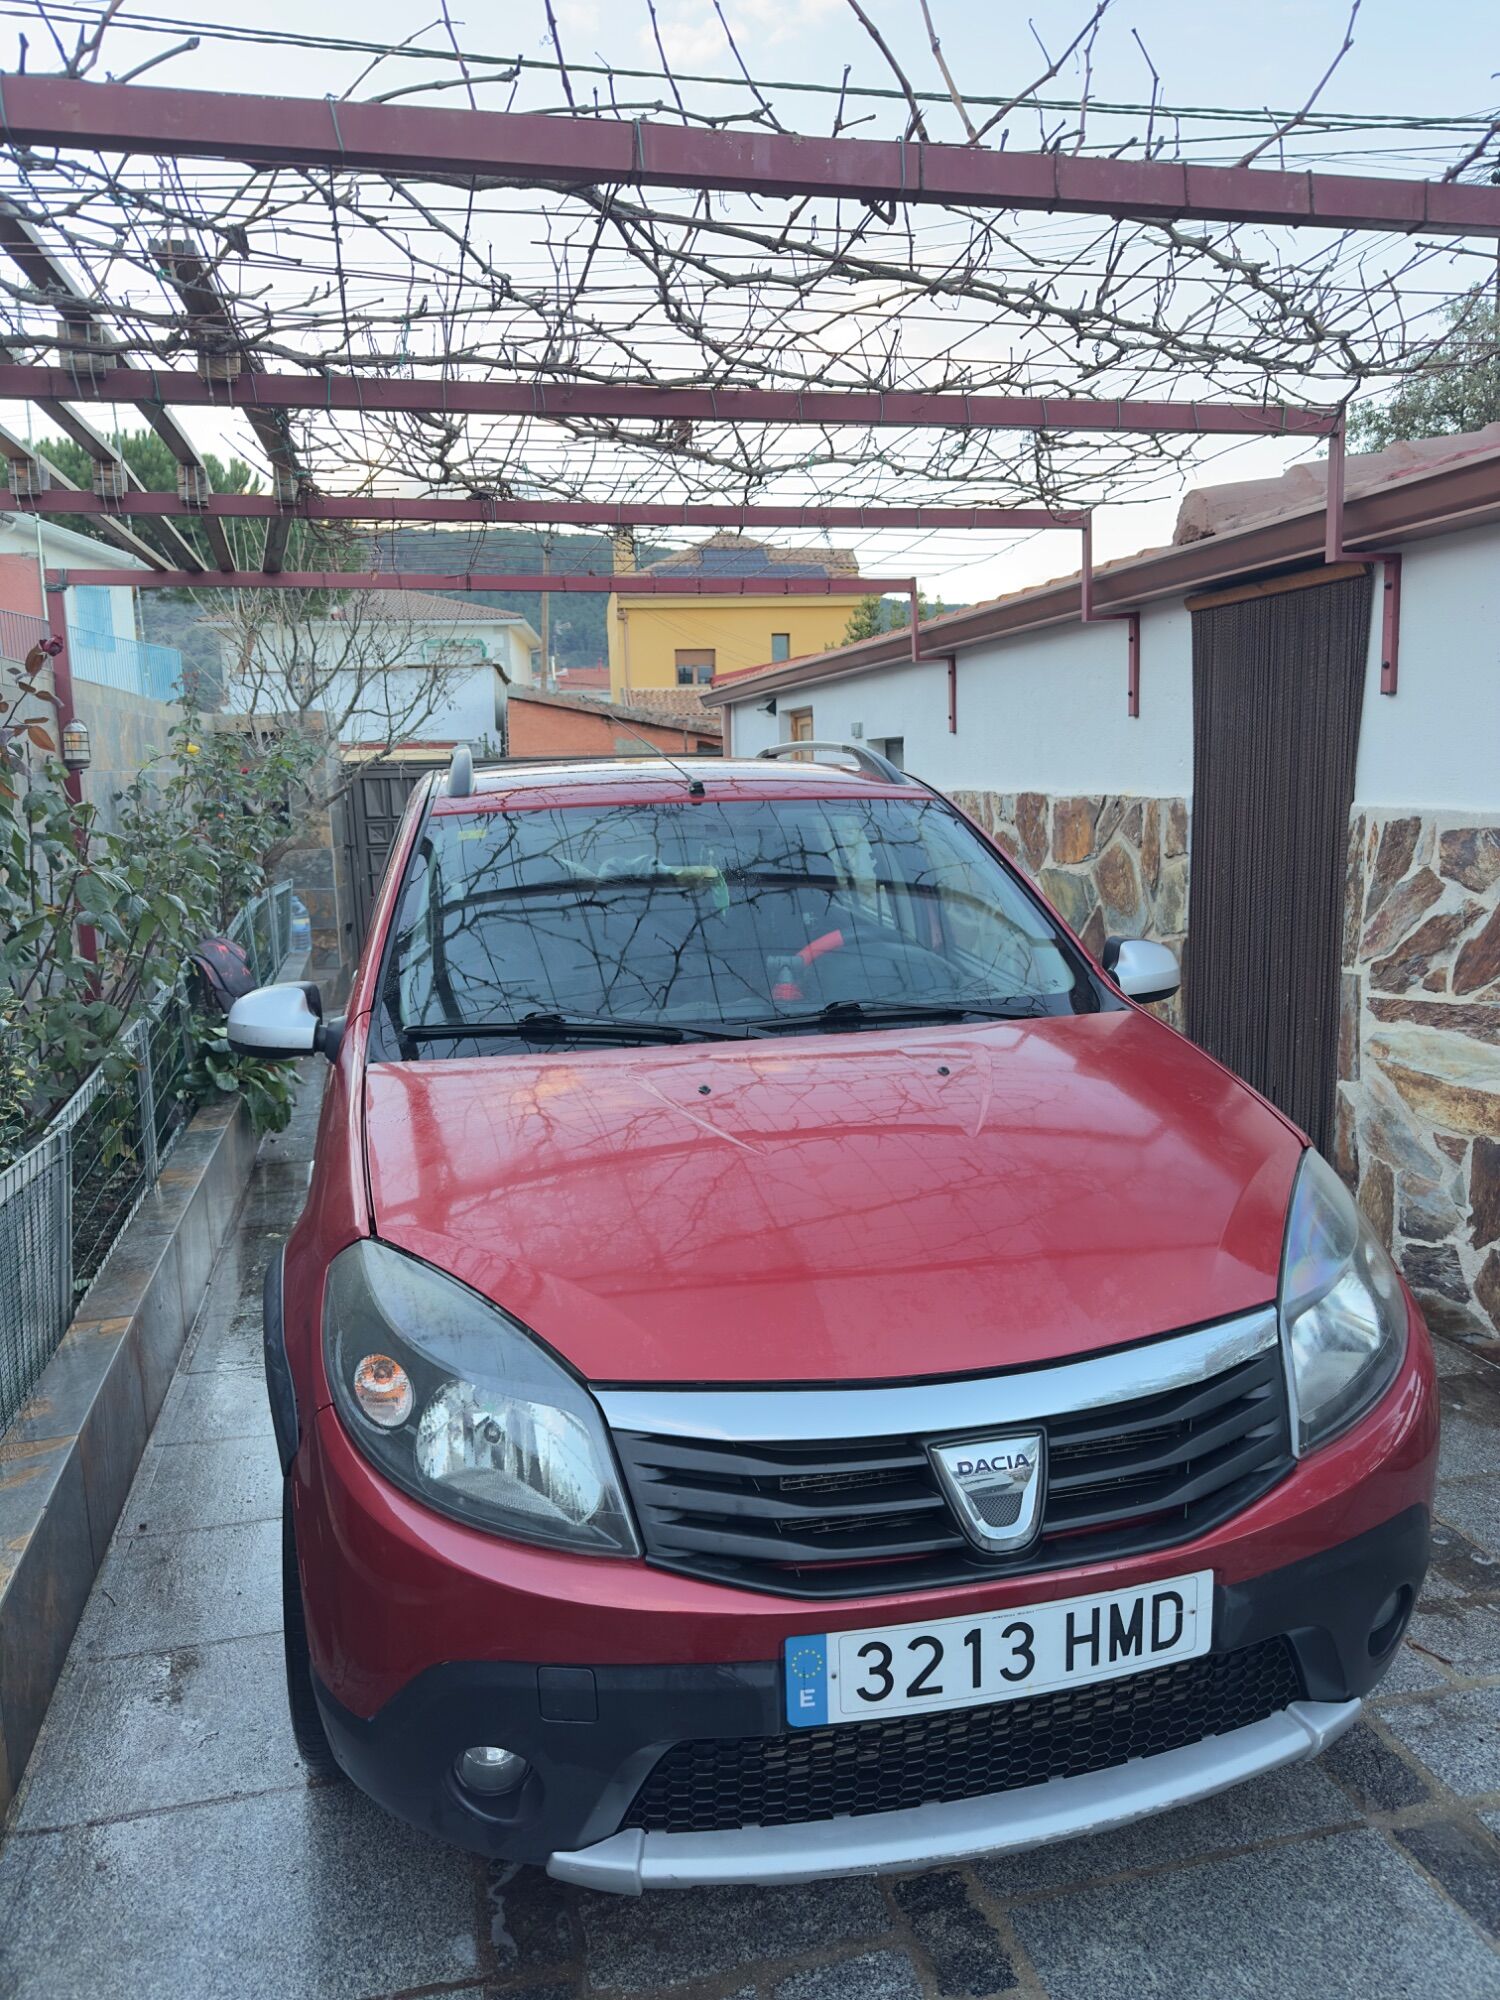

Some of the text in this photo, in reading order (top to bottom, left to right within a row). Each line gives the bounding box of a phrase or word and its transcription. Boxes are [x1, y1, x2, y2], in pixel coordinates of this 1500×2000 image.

[956, 1453, 1030, 1476] DACIA
[856, 1591, 1184, 1702] 3213 HMD
[799, 1687, 816, 1709] E
